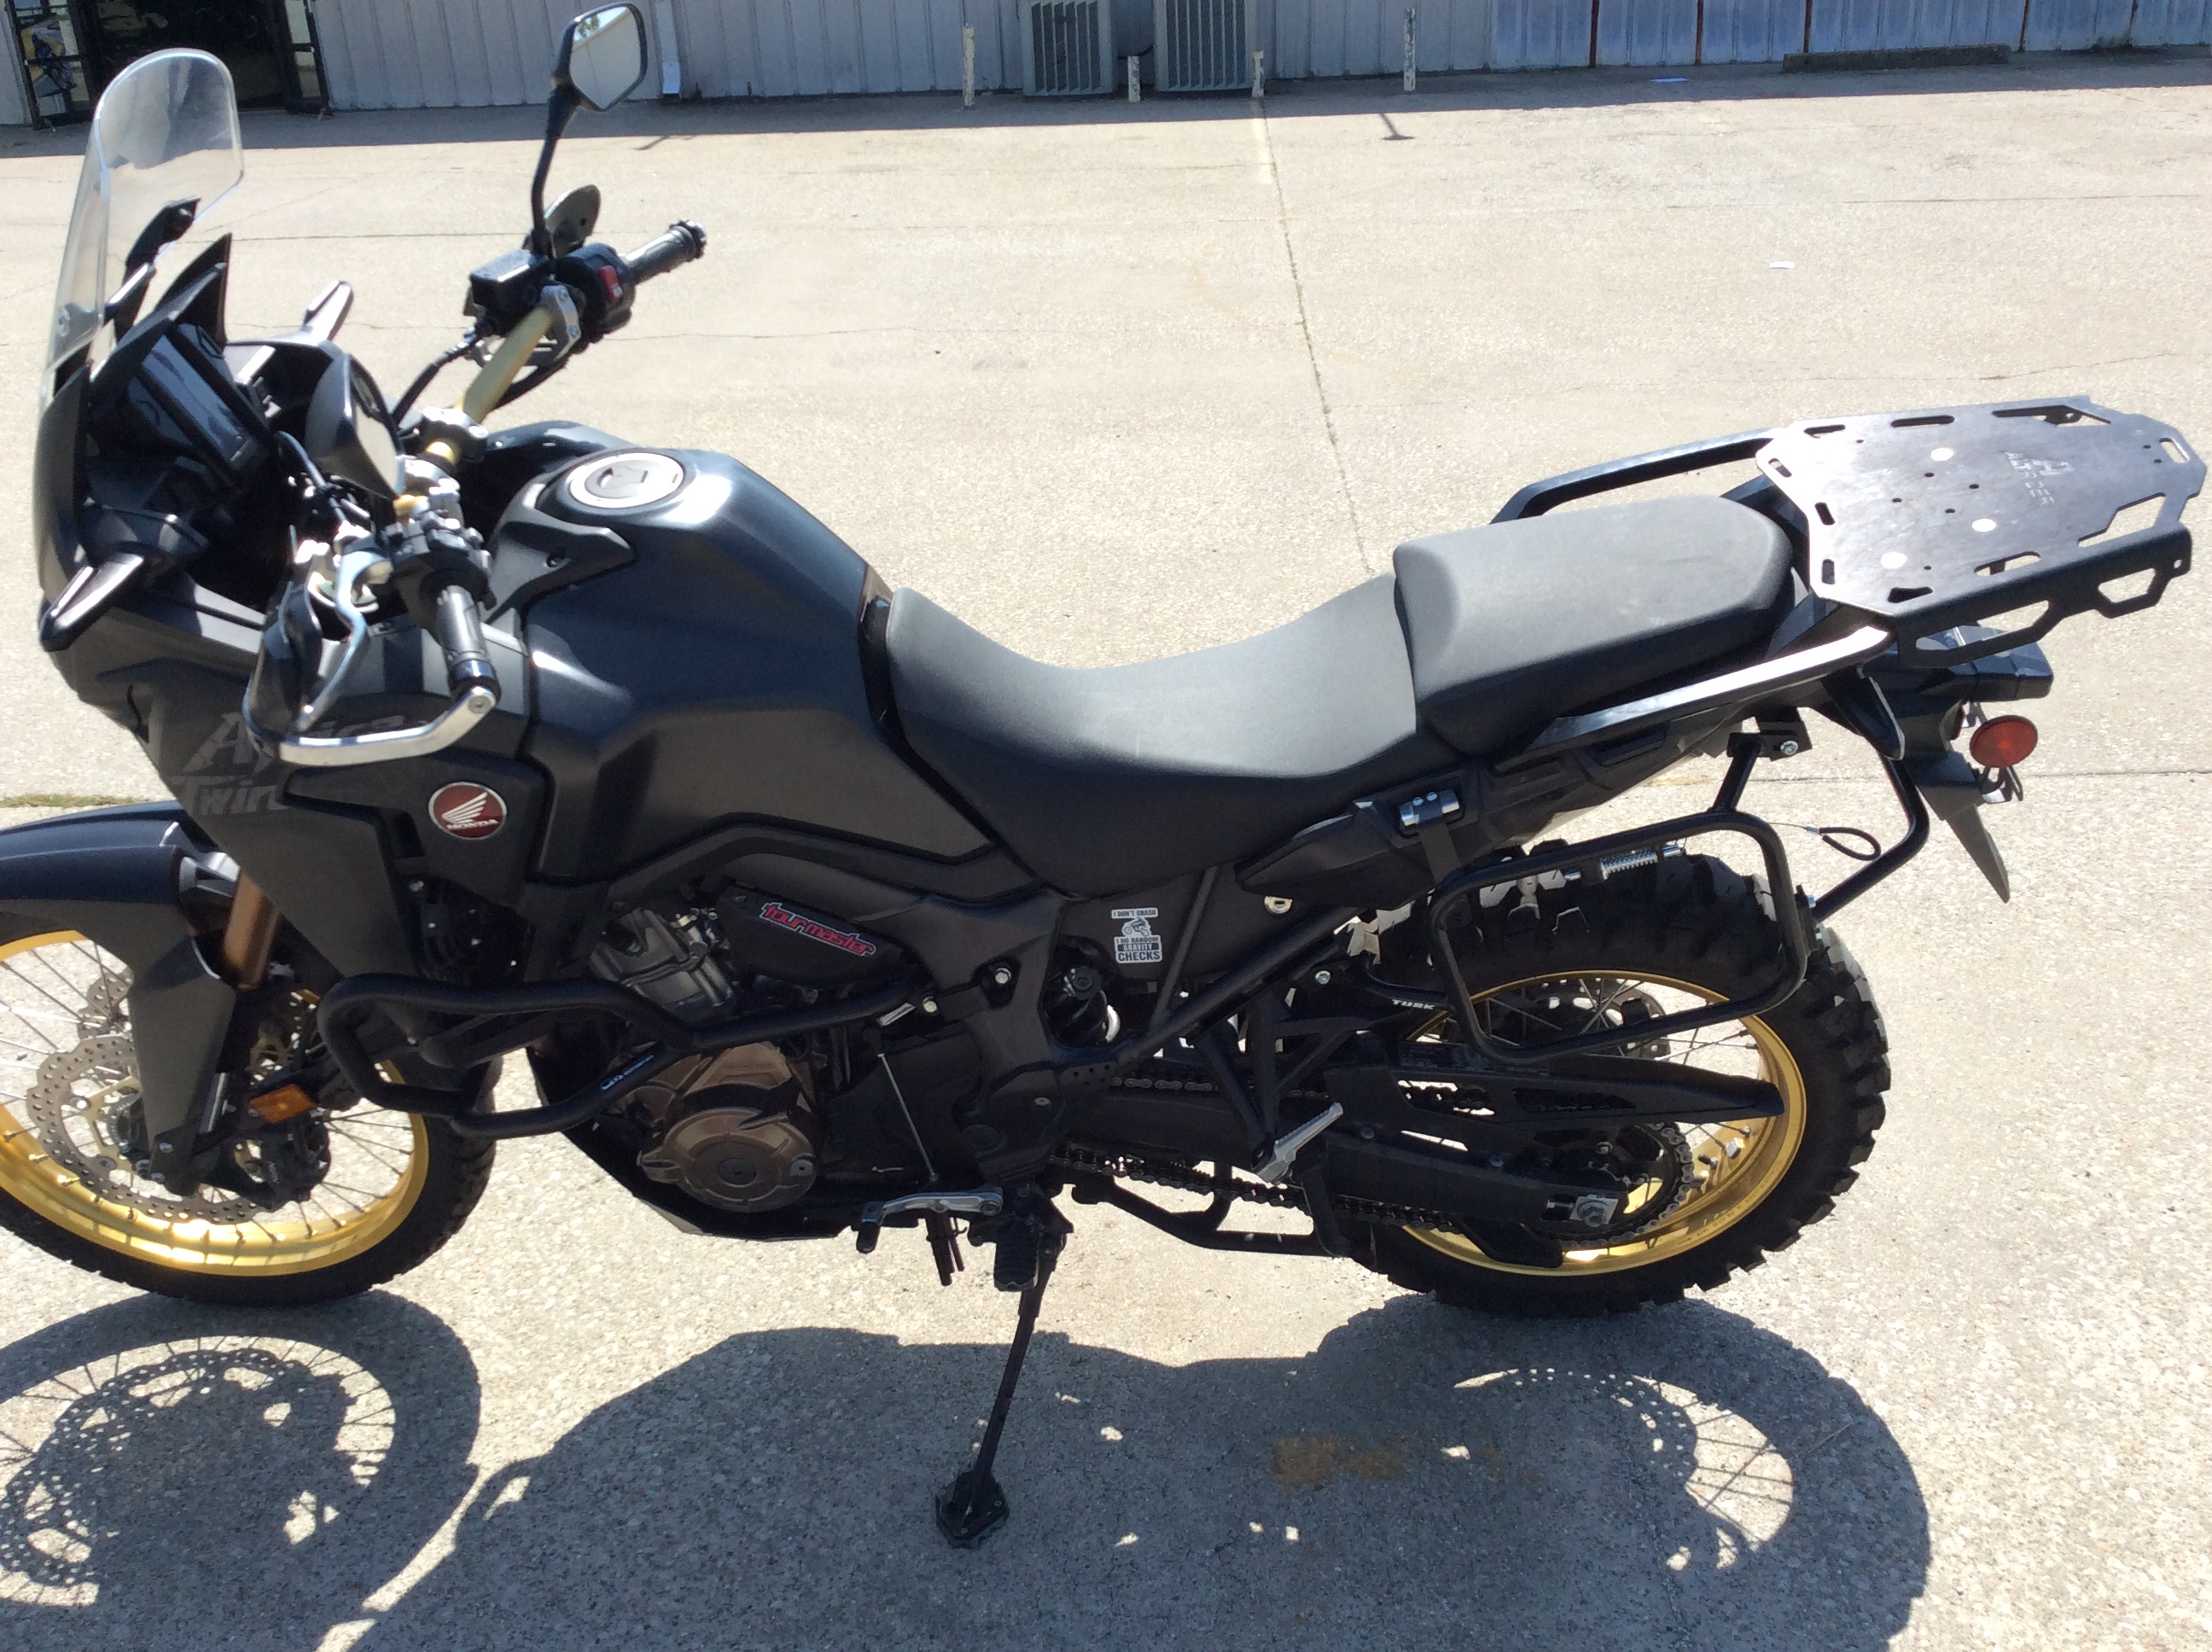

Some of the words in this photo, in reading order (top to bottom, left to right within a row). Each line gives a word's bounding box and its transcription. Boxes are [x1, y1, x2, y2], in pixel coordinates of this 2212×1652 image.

[446, 819, 499, 830] HONDA
[1123, 943, 1153, 951] GRAVITY
[1118, 951, 1161, 962] CHECKS
